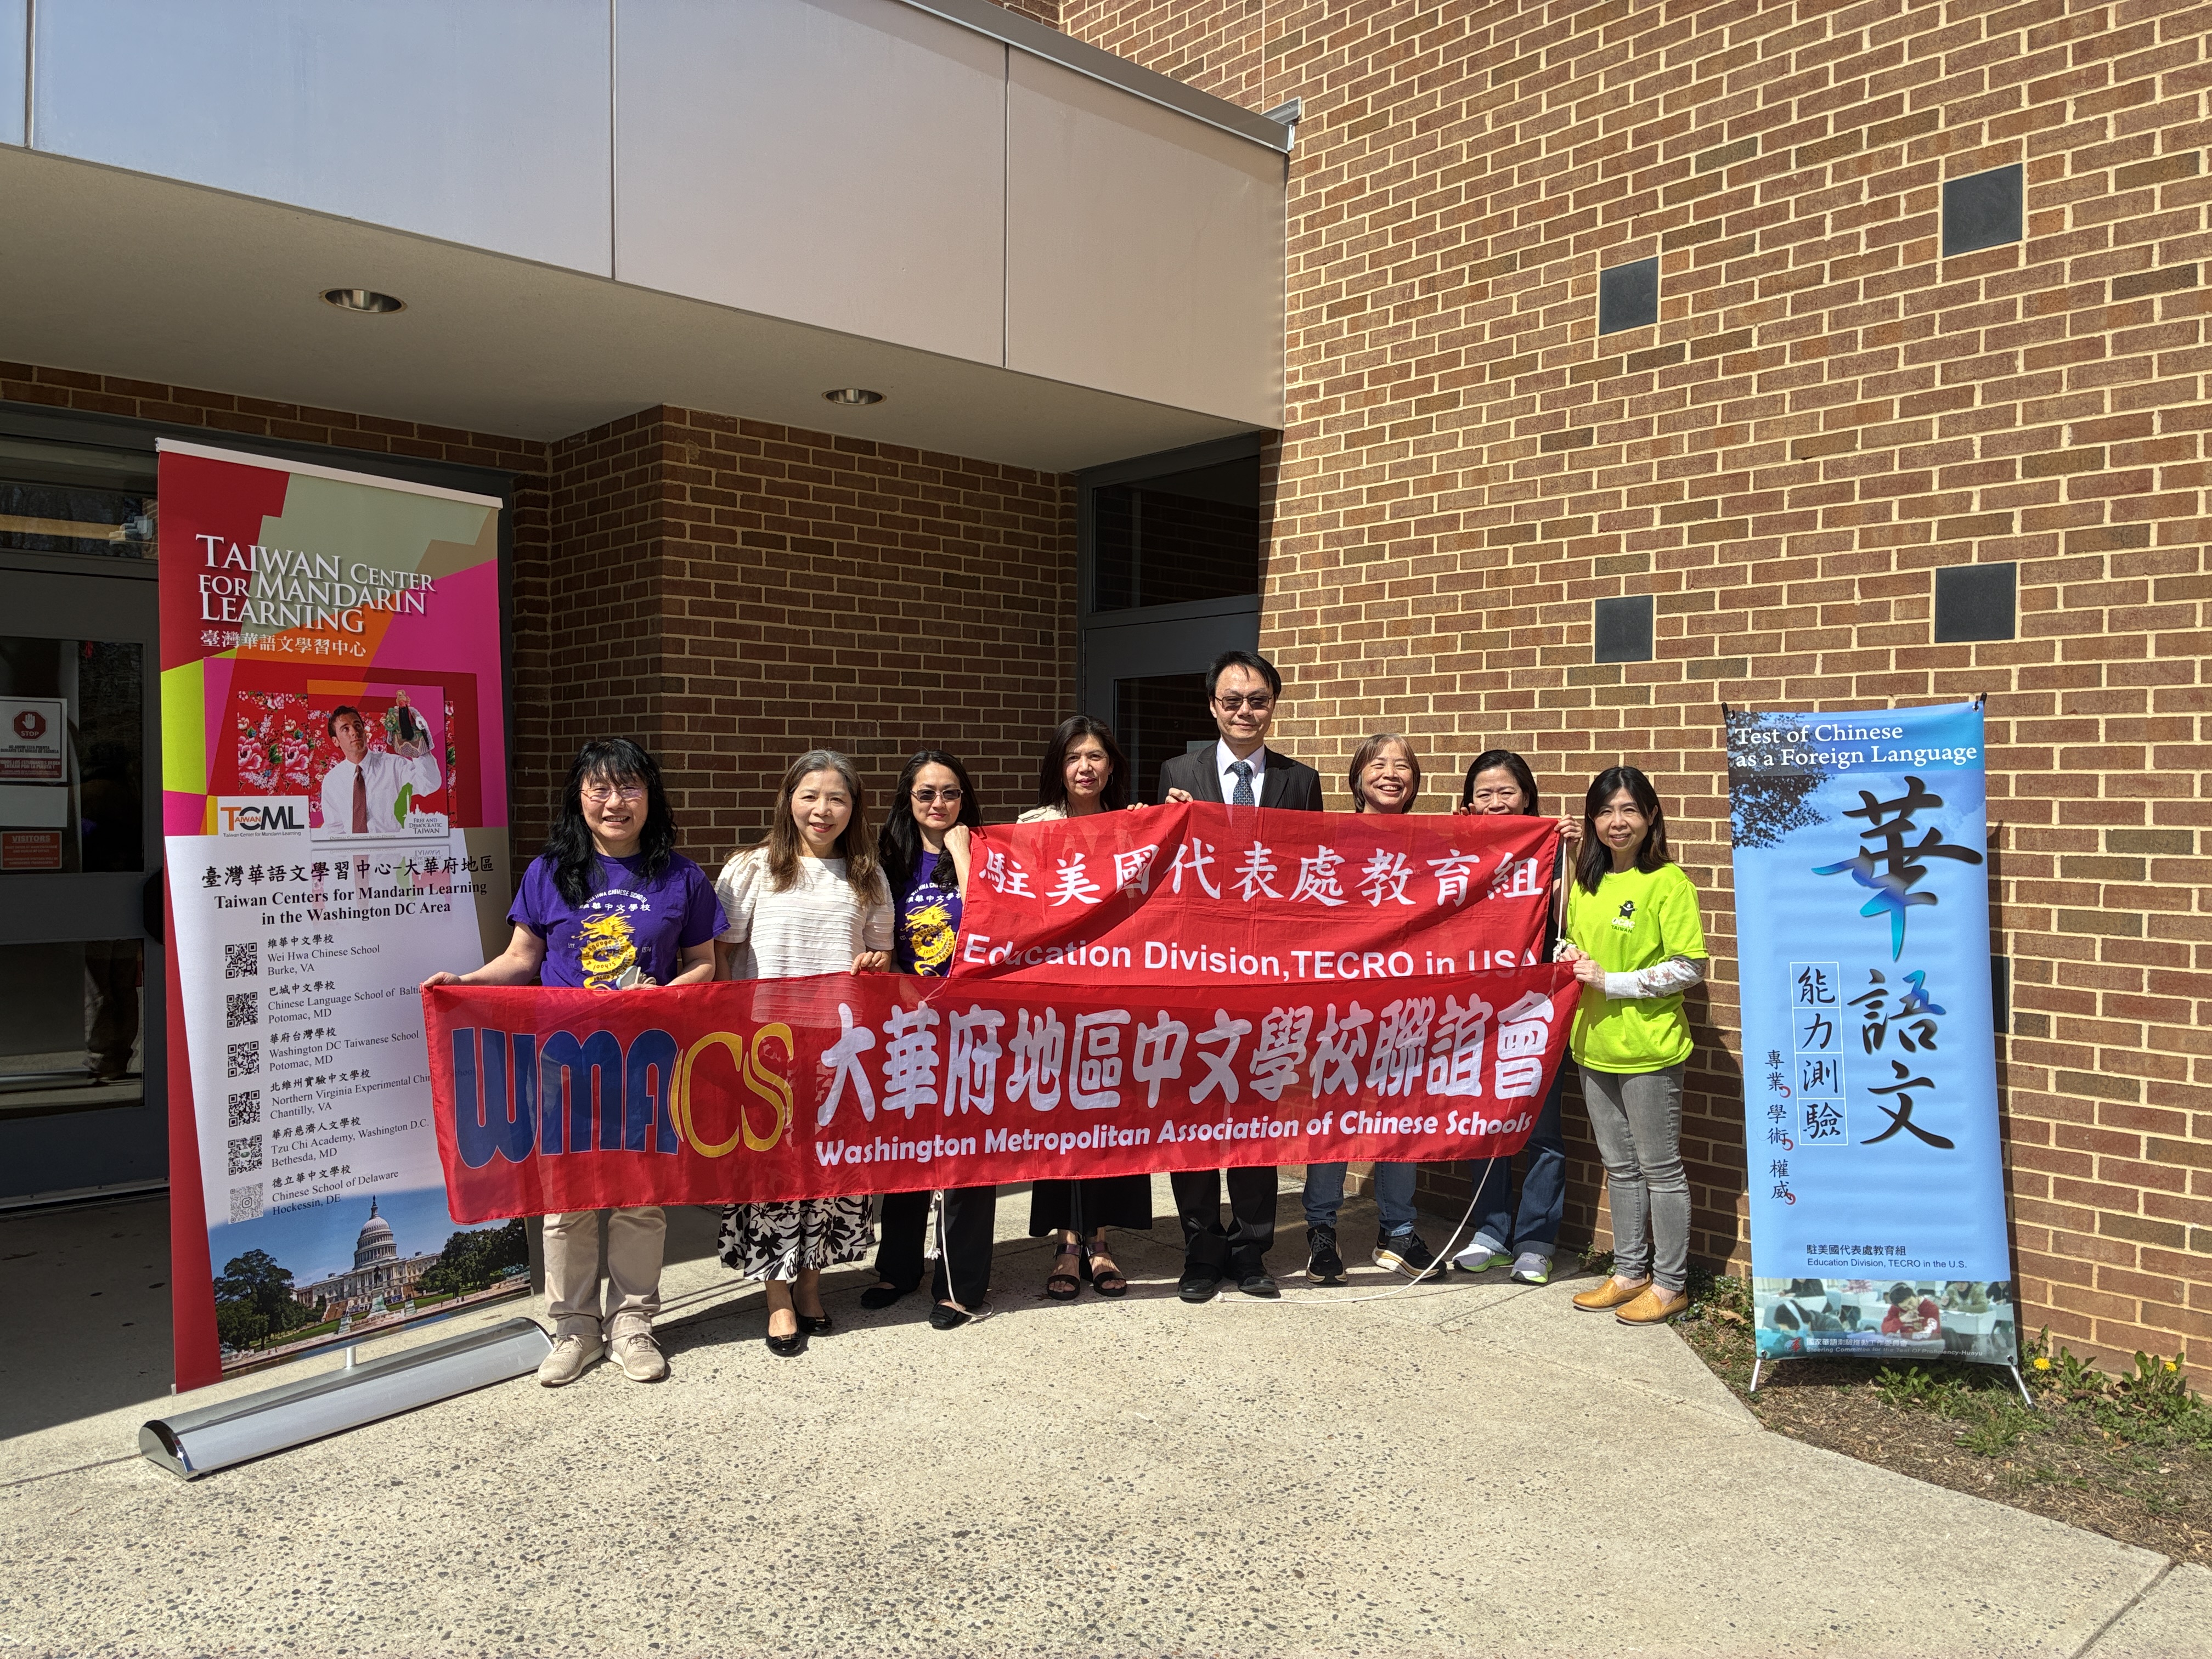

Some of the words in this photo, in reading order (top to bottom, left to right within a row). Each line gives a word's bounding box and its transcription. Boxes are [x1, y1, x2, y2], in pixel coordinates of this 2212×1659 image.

[196, 534, 341, 582] TAIWAN
[350, 563, 437, 592] CENTER
[198, 574, 251, 597] FOR
[256, 571, 427, 616] MANDARIN
[200, 592, 365, 633] LEARNING
[200, 629, 367, 657] 臺灣華語文學習中心
[1735, 727, 1780, 745] Test
[1786, 725, 1809, 742] of
[1815, 724, 1903, 743] Chinese
[1735, 754, 1757, 768] as
[1763, 753, 1775, 766] a
[1781, 747, 1865, 769] Foreign
[1870, 746, 1978, 766] Language
[221, 806, 304, 831] TCML
[979, 837, 1544, 908] 駐美國代表處教育組
[214, 895, 267, 909] Taiwan
[272, 891, 329, 905] Centers
[333, 888, 354, 901] for
[358, 884, 425, 900] Mandarin
[429, 881, 487, 895] Learning
[262, 912, 275, 926] in
[280, 911, 302, 924] the
[307, 906, 391, 922] Washington
[395, 902, 416, 916] DC
[420, 901, 451, 914] Area
[1611, 925, 1632, 933] TAIWAN
[267, 952, 284, 962] Wei
[287, 951, 309, 961] Hwa
[312, 948, 348, 959] Chinese
[351, 944, 380, 956] School
[963, 933, 1132, 971] Education
[1426, 951, 1455, 975] in
[1468, 947, 1538, 975] USA
[1810, 776, 1983, 1150] 華語文
[268, 965, 297, 976] Burke,
[300, 963, 315, 973] VA
[268, 1000, 304, 1011] Chinese
[307, 994, 352, 1007] Language
[354, 989, 383, 1001] School
[386, 988, 396, 997] of
[399, 985, 423, 996] Balti
[268, 1012, 311, 1024] Potomac,
[314, 1008, 332, 1018] MD
[269, 1043, 323, 1058] Washington
[326, 1040, 341, 1051] DC
[344, 1036, 389, 1048] Taiwanese
[391, 1030, 419, 1042] School
[269, 1059, 312, 1071] Potomac,
[314, 1055, 333, 1065] MD
[817, 989, 1555, 1127] 大華府地區中文學校聯誼會
[272, 1092, 313, 1107] Northern
[317, 1086, 352, 1099] Virginia
[356, 1075, 411, 1093] Experimental
[452, 1022, 794, 1170] WMACS
[270, 1105, 315, 1120] Chantilly,
[318, 1102, 332, 1111] VA
[271, 1144, 289, 1154] Tzu
[291, 1139, 308, 1150] Chi
[311, 1133, 356, 1148] Academy,
[358, 1123, 408, 1139] Washington
[410, 1119, 429, 1128] D.C.
[815, 1133, 977, 1166] Washington
[985, 1124, 1151, 1155] Metropolitan
[1156, 1115, 1299, 1143] Association
[1306, 1110, 1333, 1136] of
[1339, 1110, 1437, 1136] Chinese
[1446, 1110, 1533, 1137] Schools
[272, 1154, 316, 1167] Bethesda,
[319, 1148, 337, 1159] MD
[272, 1188, 309, 1202] Chinese
[312, 1182, 343, 1195] School
[346, 1178, 357, 1188] of
[358, 1171, 399, 1185] Delaware
[273, 1199, 323, 1216] Hockessin,
[326, 1193, 341, 1204] DE
[1806, 1244, 1907, 1256] 駐美國代表處教育組
[1808, 1258, 1848, 1267] Education
[1851, 1259, 1886, 1268] Division,
[1888, 1259, 1921, 1268] TECRO
[1923, 1259, 1931, 1268] in
[1933, 1260, 1946, 1268] the
[1949, 1260, 1968, 1268] U.S.
